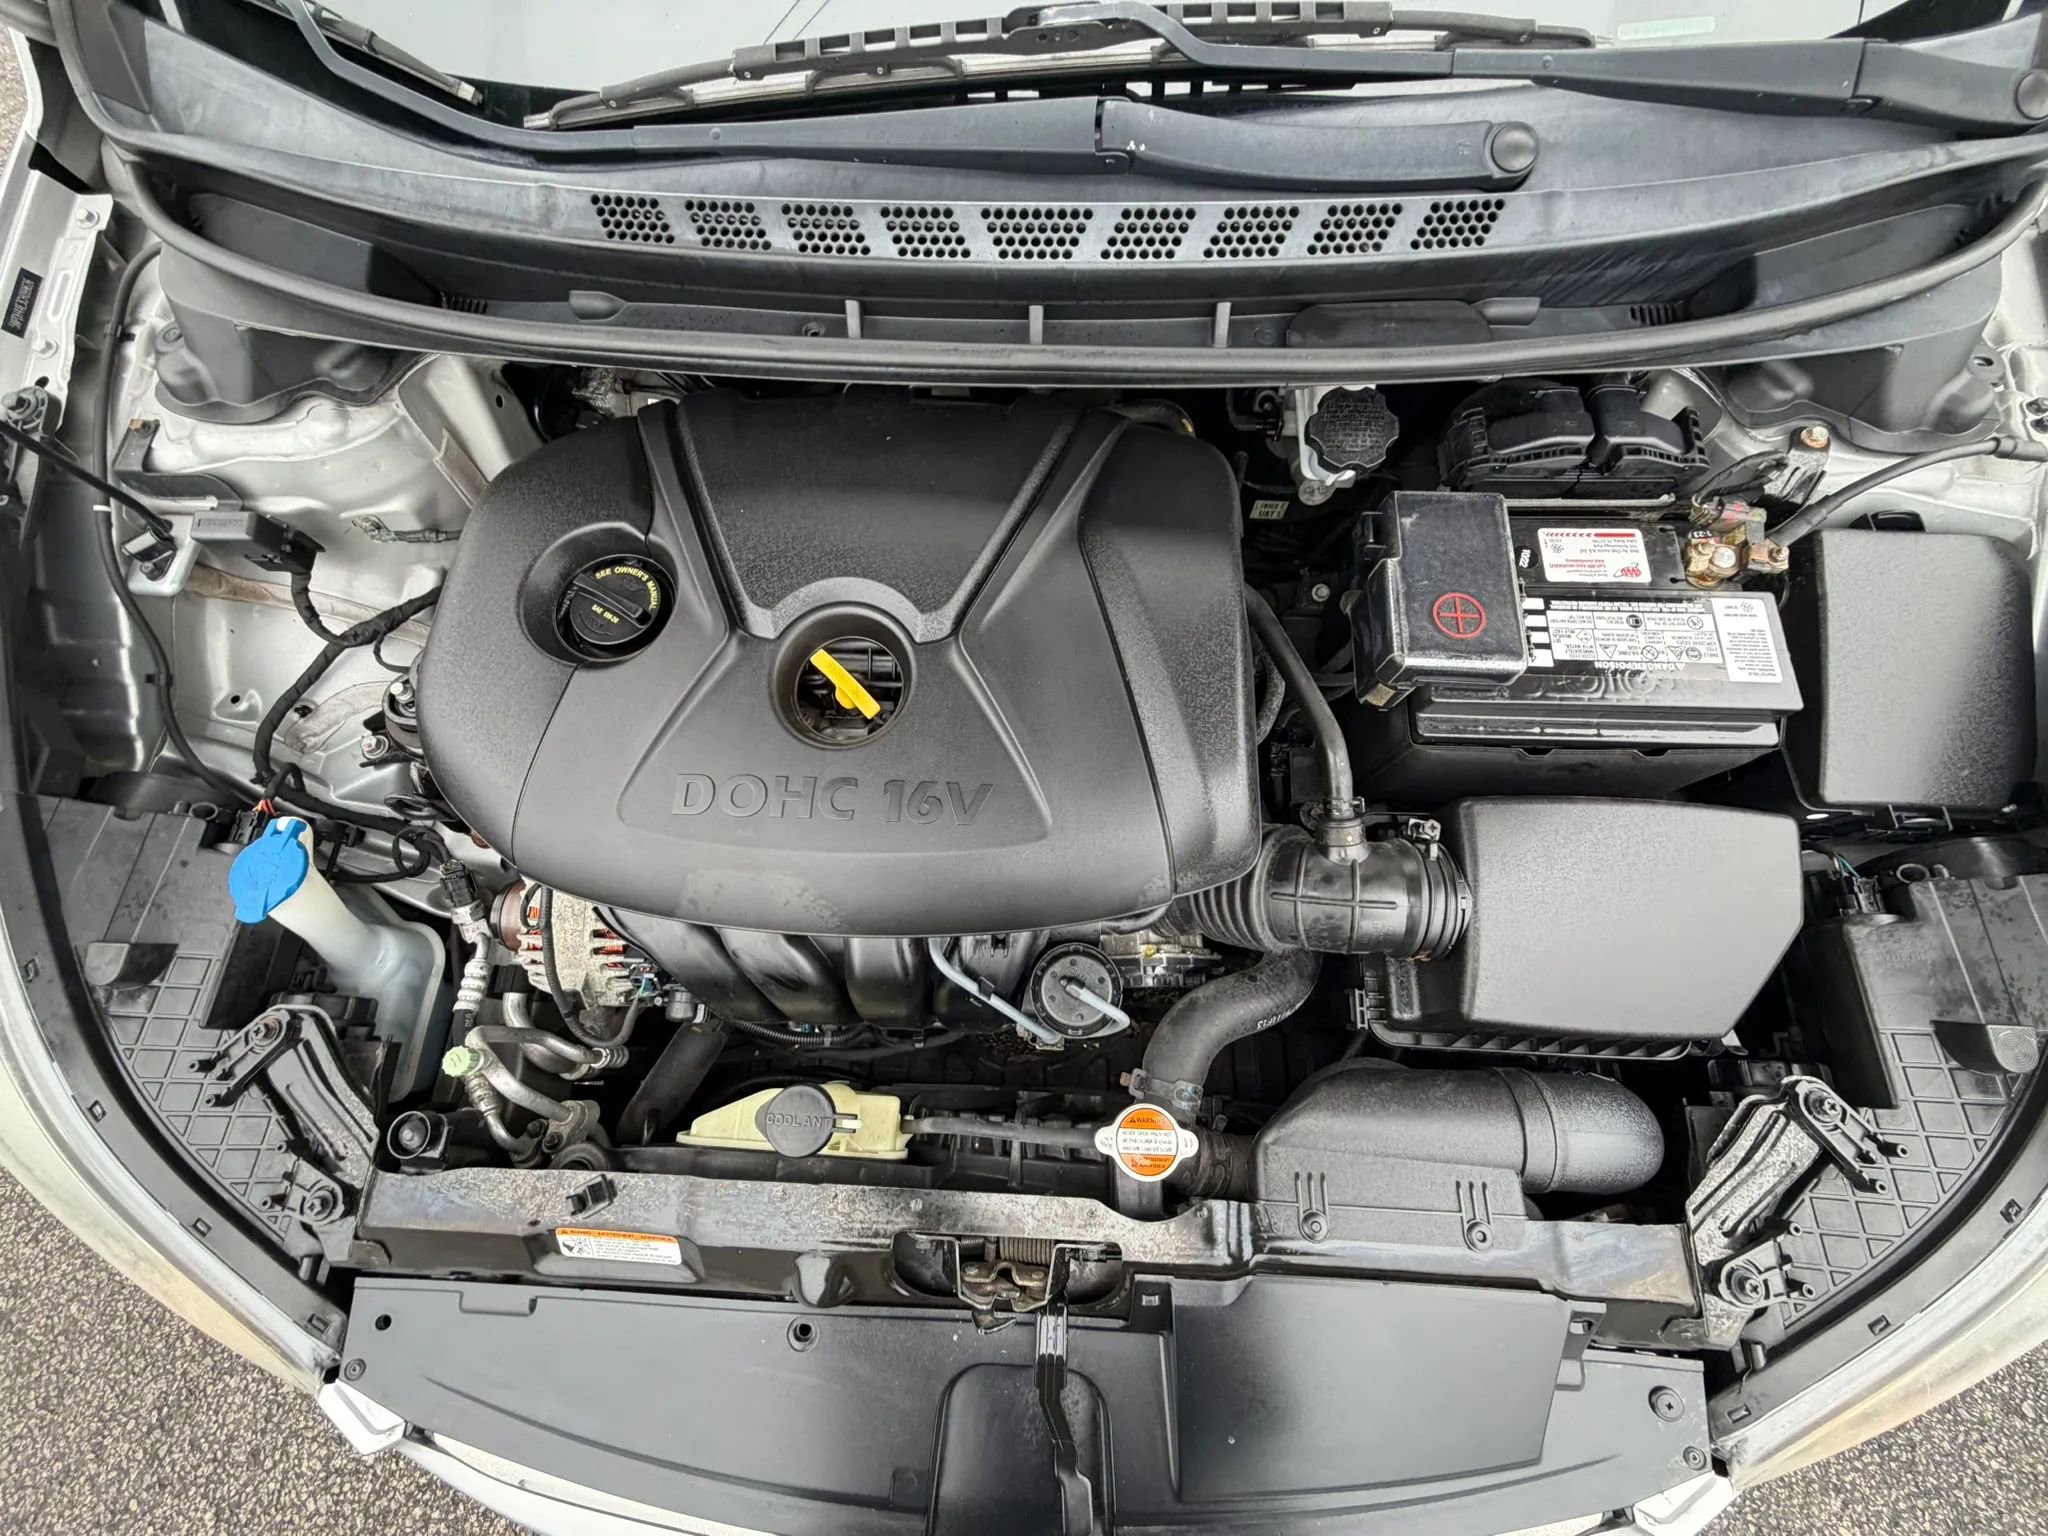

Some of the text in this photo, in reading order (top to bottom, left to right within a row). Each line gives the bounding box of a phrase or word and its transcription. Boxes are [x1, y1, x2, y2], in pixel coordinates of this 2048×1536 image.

[595, 566, 658, 611] SEE OWNER'S MANUAL
[591, 604, 604, 615] SAE
[671, 773, 994, 826] DOHC 16V
[765, 1112, 833, 1128] COOLANT
